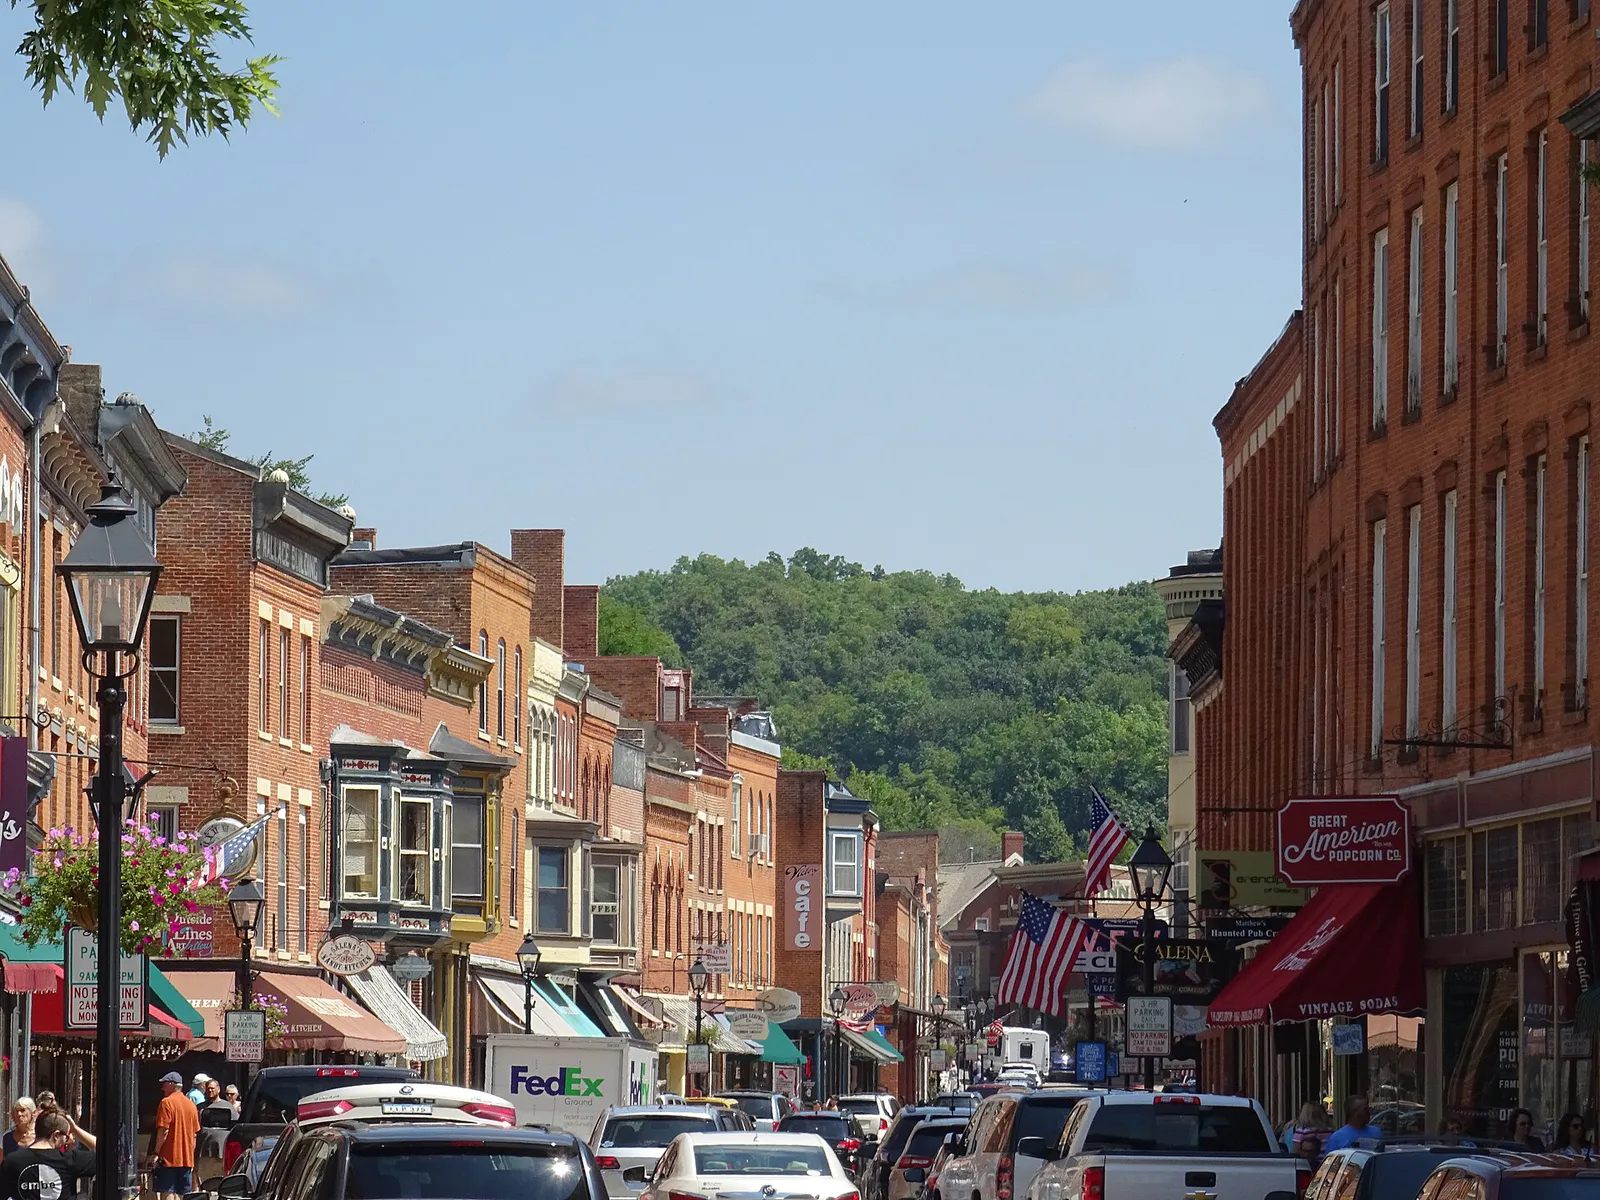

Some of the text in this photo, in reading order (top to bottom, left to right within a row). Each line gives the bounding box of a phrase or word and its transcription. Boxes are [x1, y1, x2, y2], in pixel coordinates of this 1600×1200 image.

[1309, 815, 1348, 828] GREAT
[1284, 821, 1403, 864] American
[1329, 850, 1384, 862] POPCORN
[794, 880, 811, 948] cafe
[173, 928, 213, 941] Lines
[1211, 929, 1245, 937] Haunted
[1247, 929, 1264, 937] Pub
[74, 987, 89, 999] NO
[1140, 1000, 1159, 1008] 3 HR
[1299, 996, 1399, 1016] VINTAGE SODAS
[1133, 1008, 1165, 1017] PARKING
[232, 1021, 259, 1029] PARKING
[291, 1024, 323, 1033] KITCHEN
[1140, 1031, 1168, 1039] PARKING
[510, 1065, 605, 1098] FedEx
[564, 1097, 594, 1107] Ground
